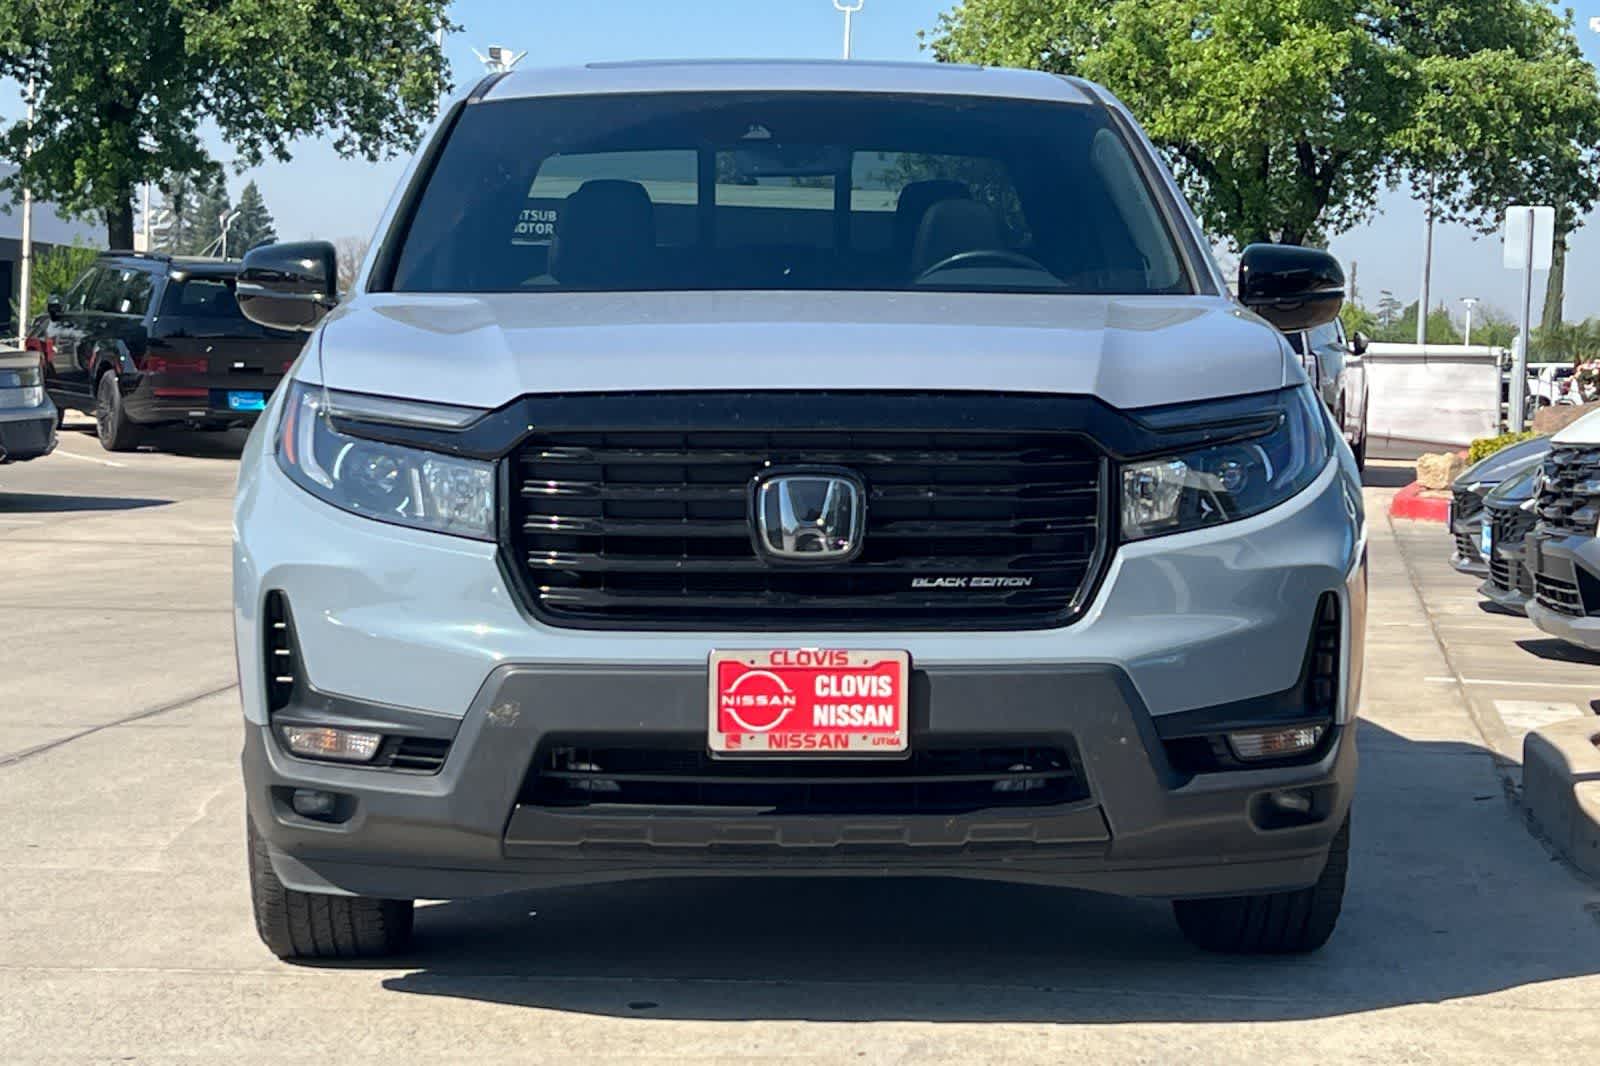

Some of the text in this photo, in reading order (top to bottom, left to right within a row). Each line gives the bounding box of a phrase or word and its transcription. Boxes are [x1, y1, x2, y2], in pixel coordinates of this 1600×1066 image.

[911, 576, 1033, 588] BLACK EDITION
[769, 650, 849, 666] CLOVIS
[815, 674, 893, 697] CLOVIS
[721, 694, 796, 706] NISSAN
[812, 704, 894, 727] NISSAN
[768, 734, 849, 748] NISSAN
